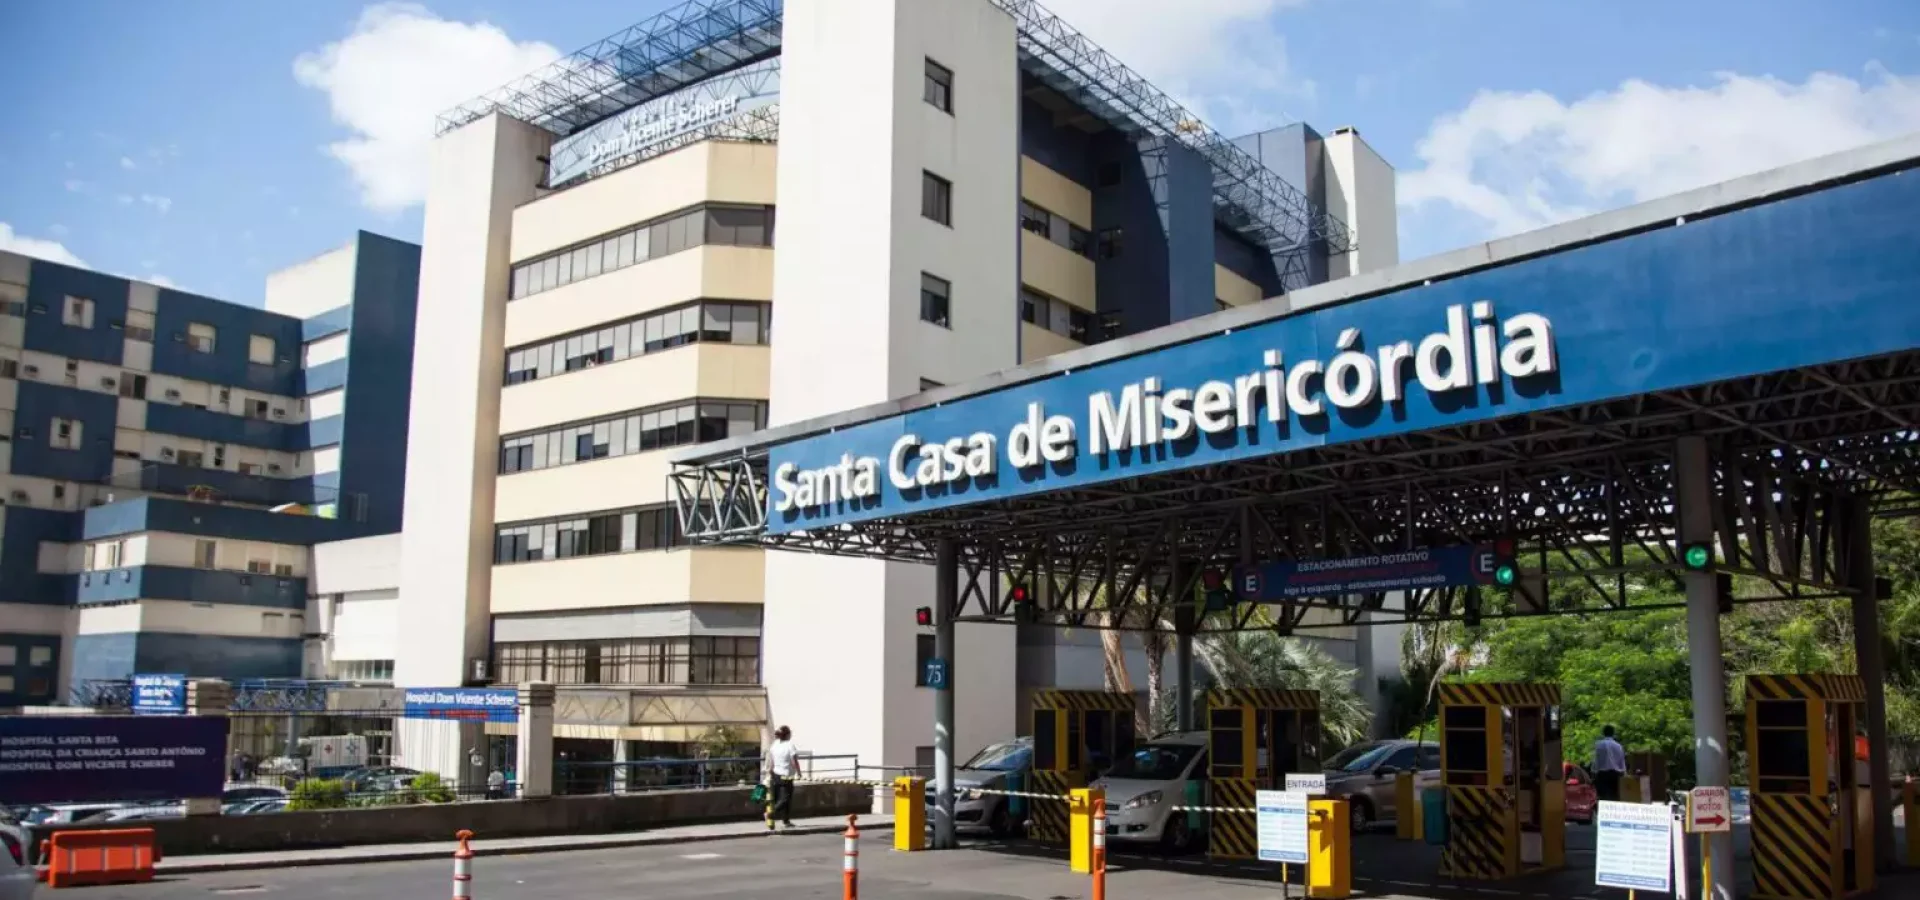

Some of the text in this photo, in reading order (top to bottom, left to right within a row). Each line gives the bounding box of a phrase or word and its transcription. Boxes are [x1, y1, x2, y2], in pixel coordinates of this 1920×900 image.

[590, 96, 738, 161] Dom Vicente Scherer
[775, 301, 1556, 511] Santa Casa de Misericórdia
[1297, 551, 1429, 572] ESTACIONAMENTO ROTATIVO
[1480, 554, 1494, 572] E
[1245, 575, 1256, 592] E
[927, 664, 942, 683] 75
[405, 691, 516, 706] Hospital Dom Vicente Scherer
[1, 735, 119, 746] HOSPITAL SANTA RITA
[1, 746, 206, 758] HOSPITAL DA CRIANÇA SANTO ANTÔNIO
[0, 759, 175, 771] HOSPITAL DOM VICENTE SCHERER
[1287, 779, 1325, 789] ENTRADA
